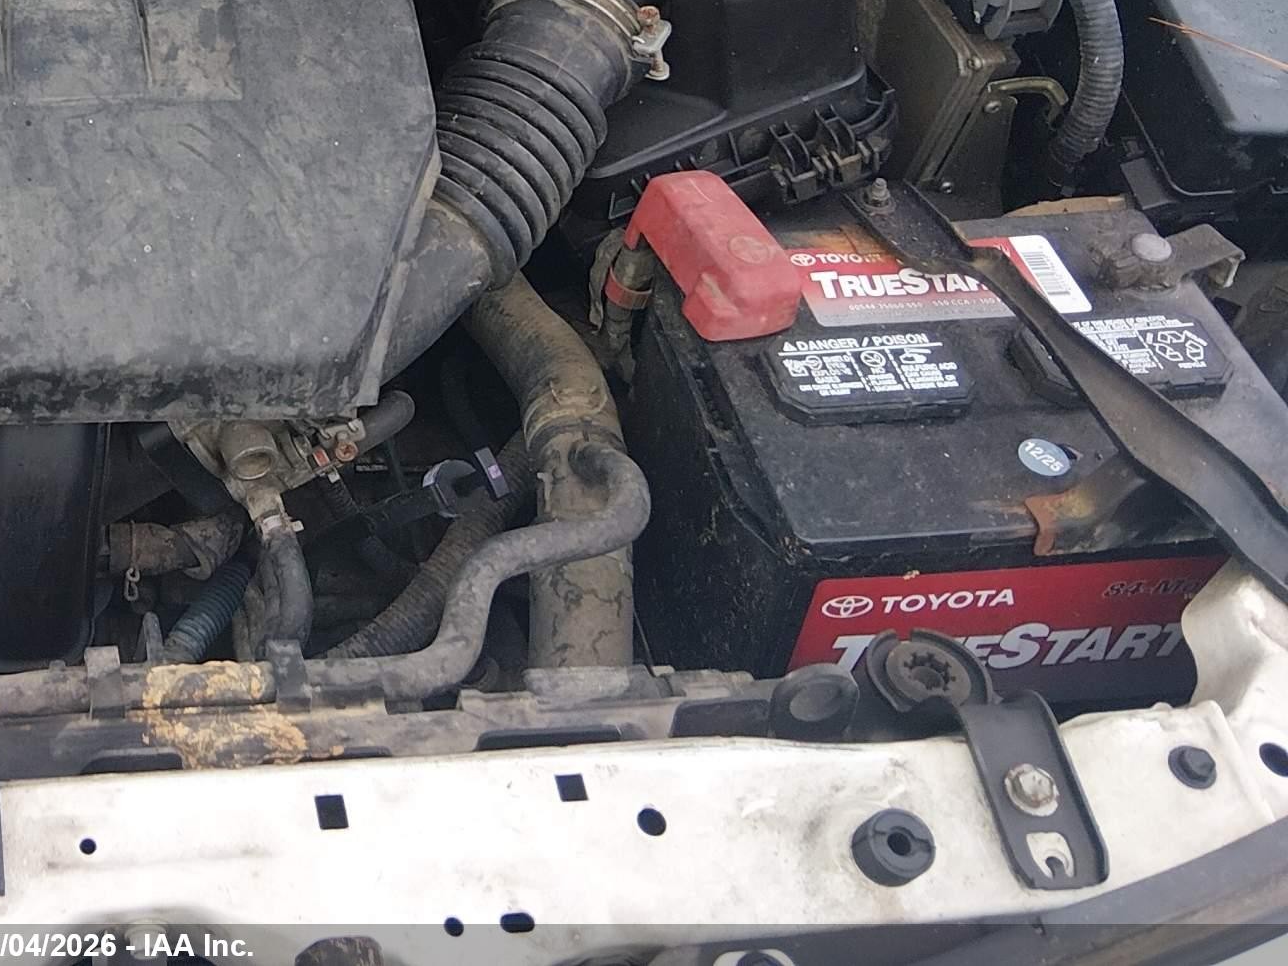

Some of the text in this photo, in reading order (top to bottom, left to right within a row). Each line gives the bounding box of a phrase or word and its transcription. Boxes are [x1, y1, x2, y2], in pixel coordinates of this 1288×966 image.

[796, 334, 929, 352] DANGER / POISON
[1024, 441, 1065, 472] 12/25
[881, 589, 1015, 614] TOYOTA
